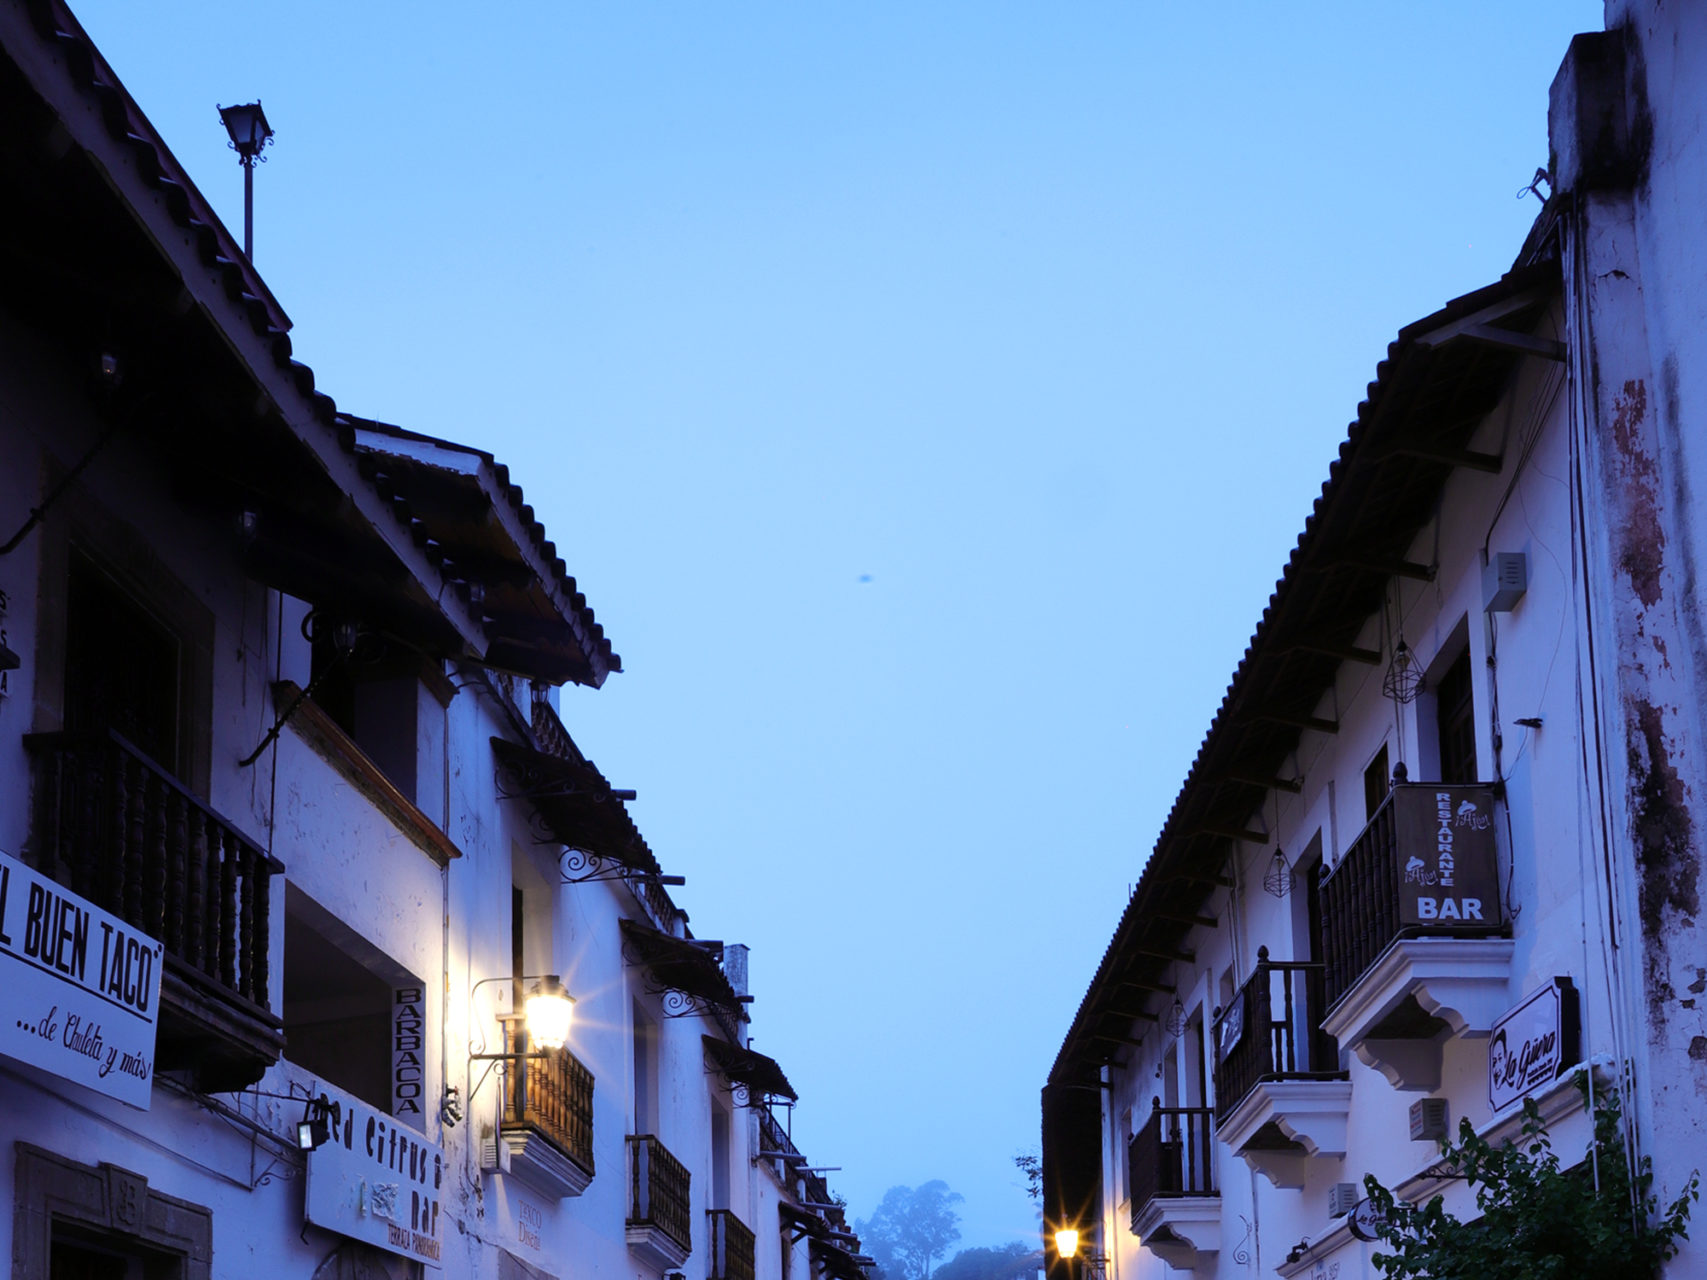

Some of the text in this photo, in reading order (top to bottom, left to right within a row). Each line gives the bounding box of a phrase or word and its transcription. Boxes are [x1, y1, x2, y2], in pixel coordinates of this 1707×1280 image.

[1436, 793, 1454, 887] RESTAURANTE
[0, 863, 152, 1012] L BUEN TACO
[1417, 897, 1483, 920] BAR
[62, 1012, 104, 1061] Chuleta
[98, 1046, 119, 1079] y
[119, 1051, 152, 1081] más
[395, 988, 422, 1116] BARBACOA
[1516, 1031, 1556, 1091] Güera
